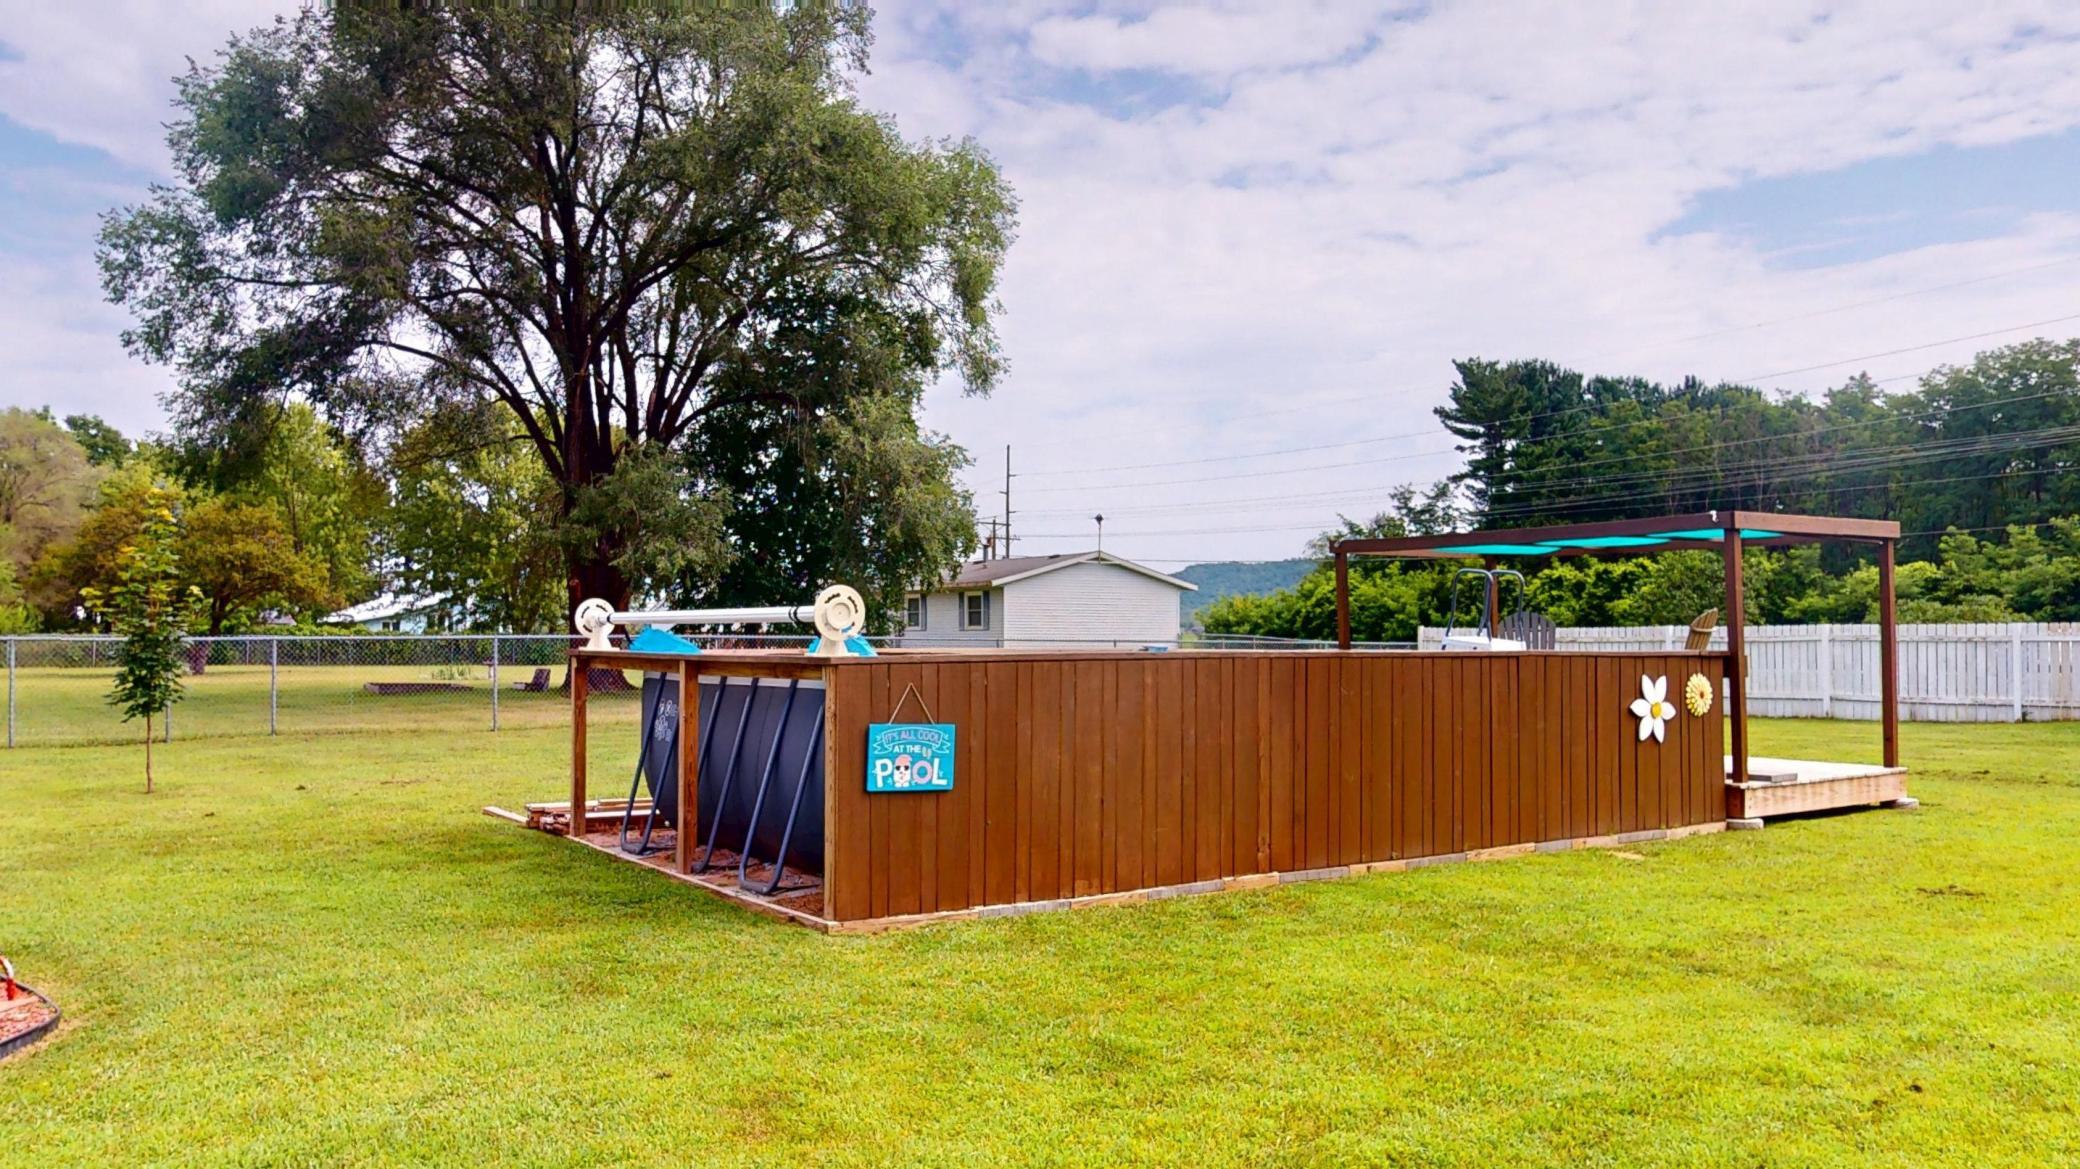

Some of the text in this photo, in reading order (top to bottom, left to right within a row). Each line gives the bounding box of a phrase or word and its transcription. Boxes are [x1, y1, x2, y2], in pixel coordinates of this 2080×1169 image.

[901, 730, 916, 740] ALL
[919, 730, 940, 744] COOL
[893, 745, 921, 753] AT THE
